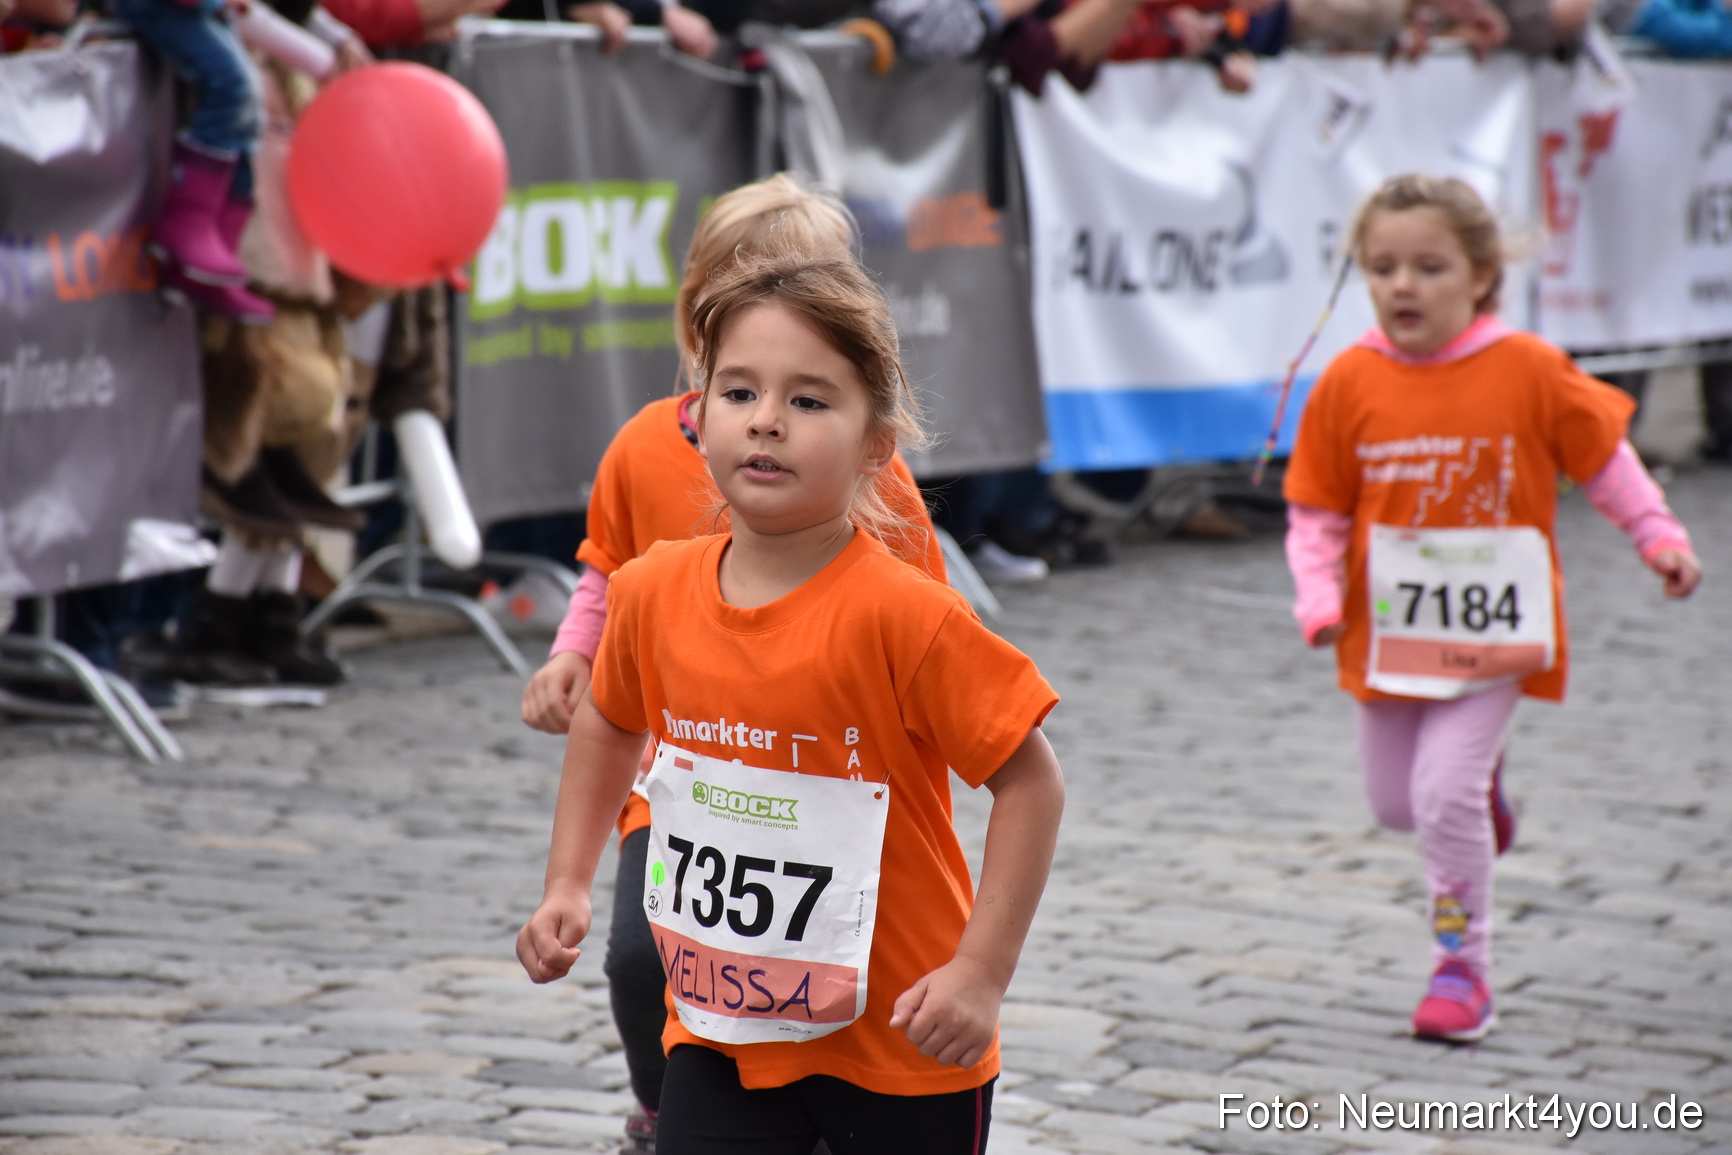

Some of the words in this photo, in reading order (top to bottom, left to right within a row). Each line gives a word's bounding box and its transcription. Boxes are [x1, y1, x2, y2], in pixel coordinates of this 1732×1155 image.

[1397, 581, 1522, 634] 7184
[708, 808, 731, 821] inspired
[731, 814, 741, 824] by
[741, 817, 762, 827] smart
[763, 821, 799, 831] concepts
[710, 785, 799, 823] BOCK
[667, 833, 834, 942] 7357
[659, 936, 813, 1020] MELISSA
